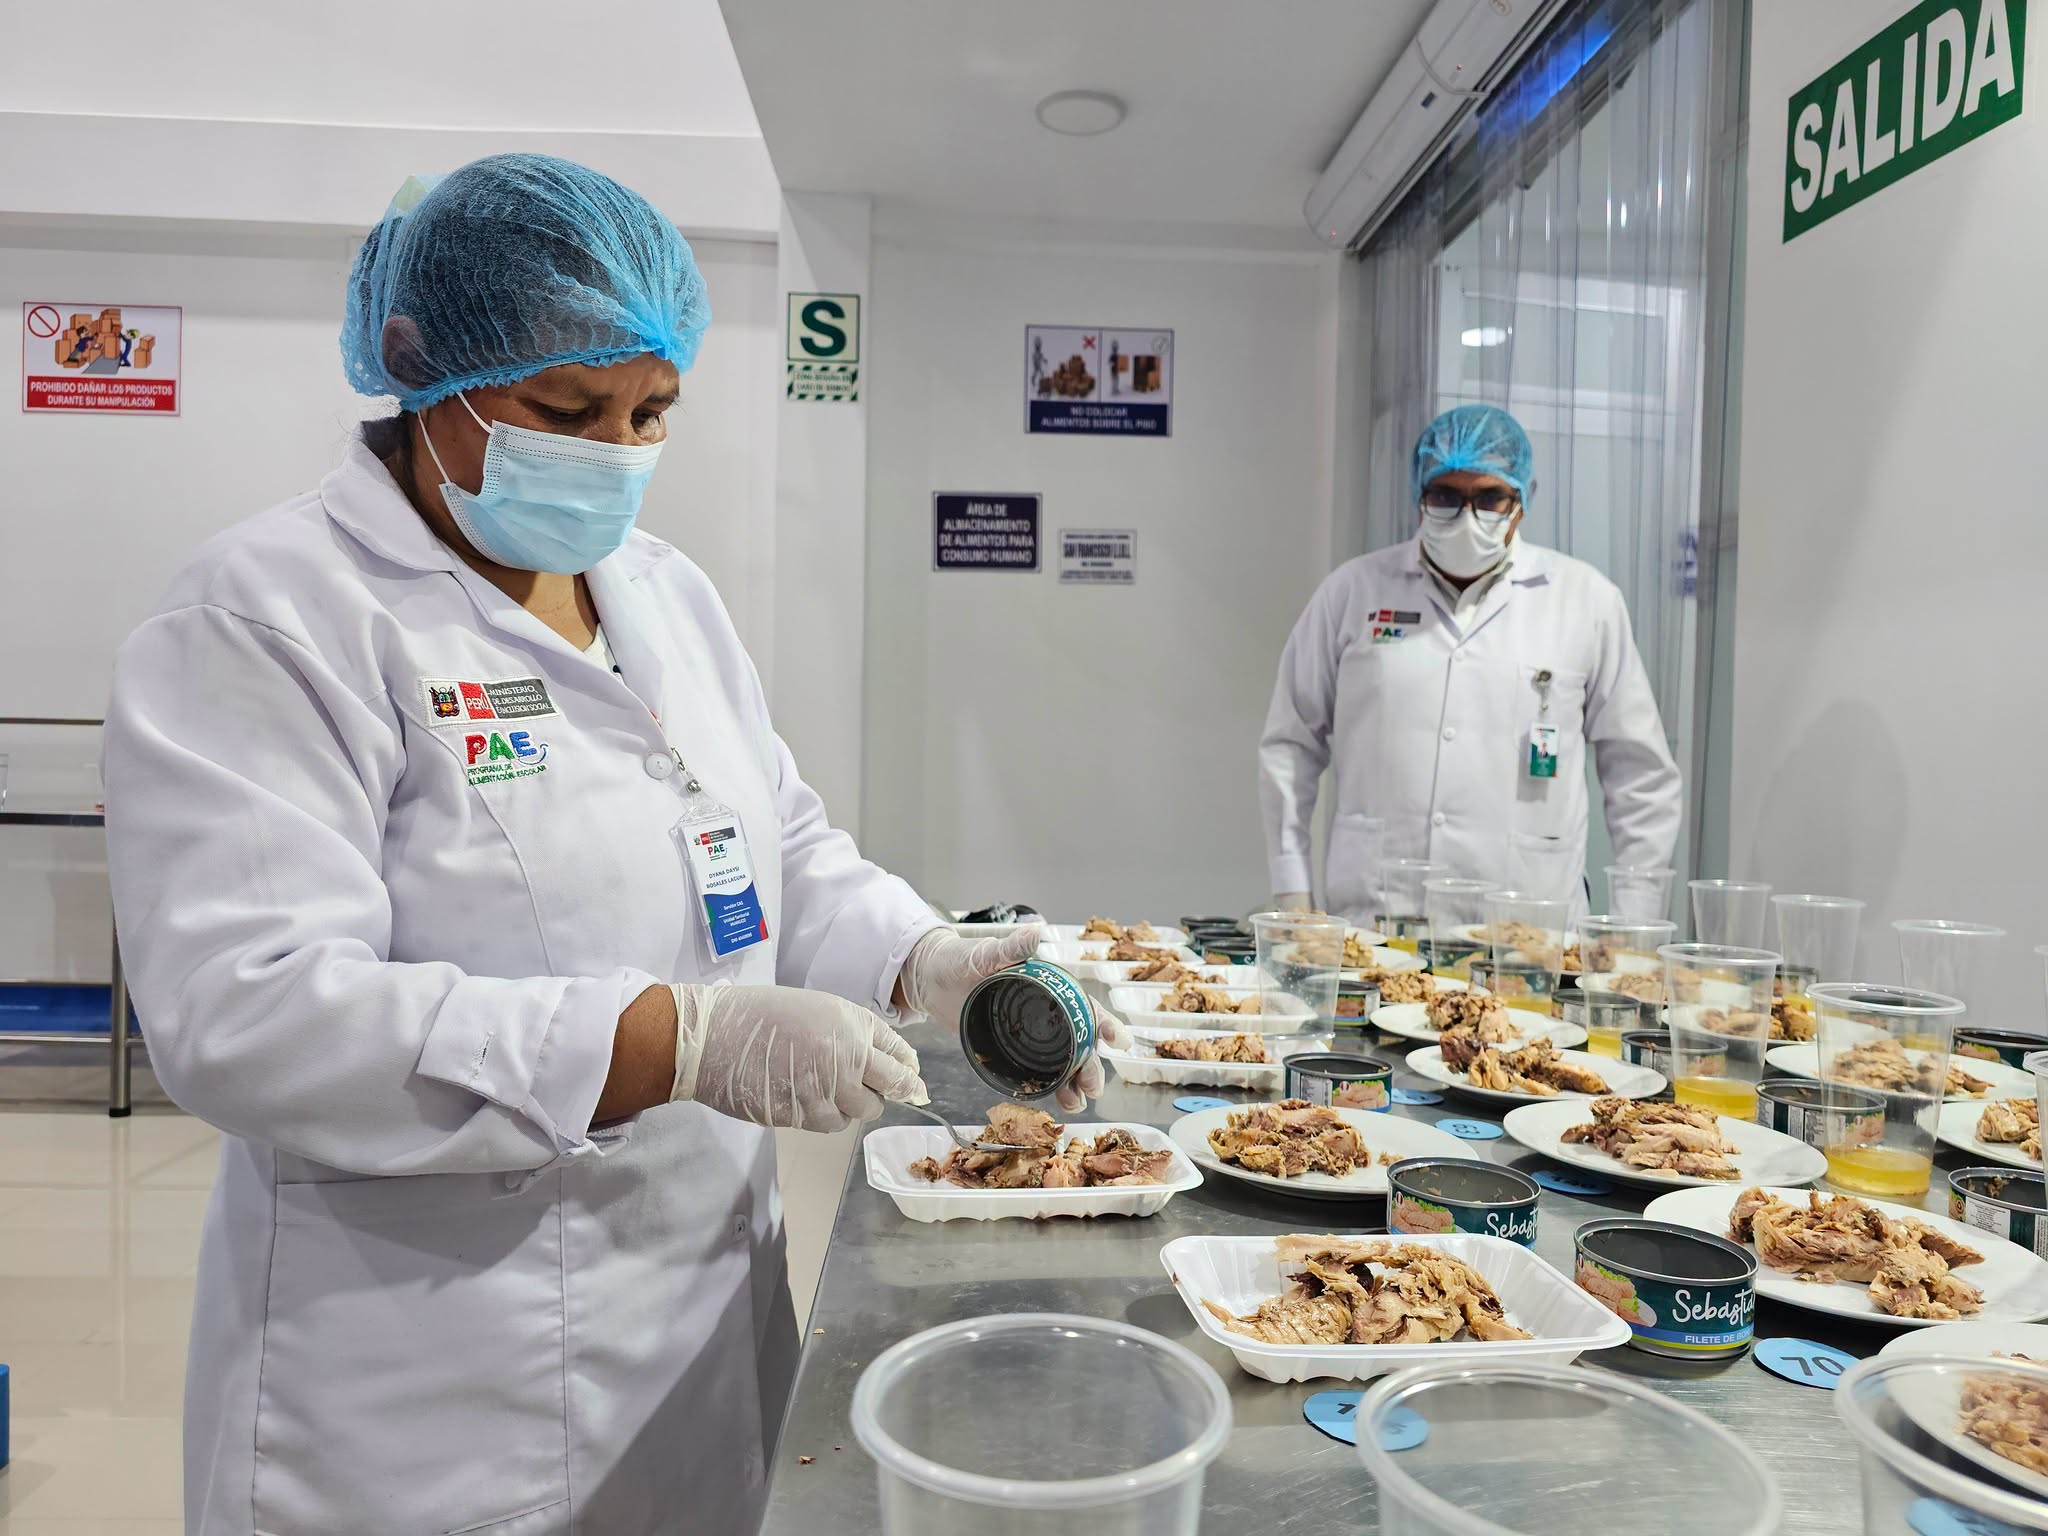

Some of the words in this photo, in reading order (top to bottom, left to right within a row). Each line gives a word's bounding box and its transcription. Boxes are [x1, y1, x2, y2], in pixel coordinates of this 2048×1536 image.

[1790, 0, 2015, 213] SALIDA
[800, 300, 847, 356] S
[31, 381, 76, 393] PROHIBIDO
[78, 381, 107, 394] DAÑAR
[108, 383, 123, 394] LOS
[125, 384, 173, 395] PRODUCTOS
[47, 395, 84, 406] DURANTE
[86, 396, 97, 406] SU
[97, 395, 155, 407] MANIPULACIÓN
[966, 501, 993, 516] ÁREA
[994, 503, 1008, 517] DE
[942, 519, 1031, 532] ALMACENAMIENTO
[939, 533, 953, 546] DE
[953, 534, 1008, 547] ALIMENTOS
[1008, 534, 1035, 547] PARA
[941, 549, 990, 562] CONSUMO
[991, 550, 1032, 563] HUMANO
[489, 685, 535, 696] MINISTERIO
[465, 731, 537, 764] PAE
[467, 764, 503, 776] PROGRAMA
[504, 763, 513, 771] DE
[516, 764, 547, 778] ESCOLAR
[707, 844, 725, 856] PAE
[1685, 1335, 1721, 1344] FILETE
[1723, 1334, 1735, 1342] DE
[1779, 1356, 1847, 1376] 70
